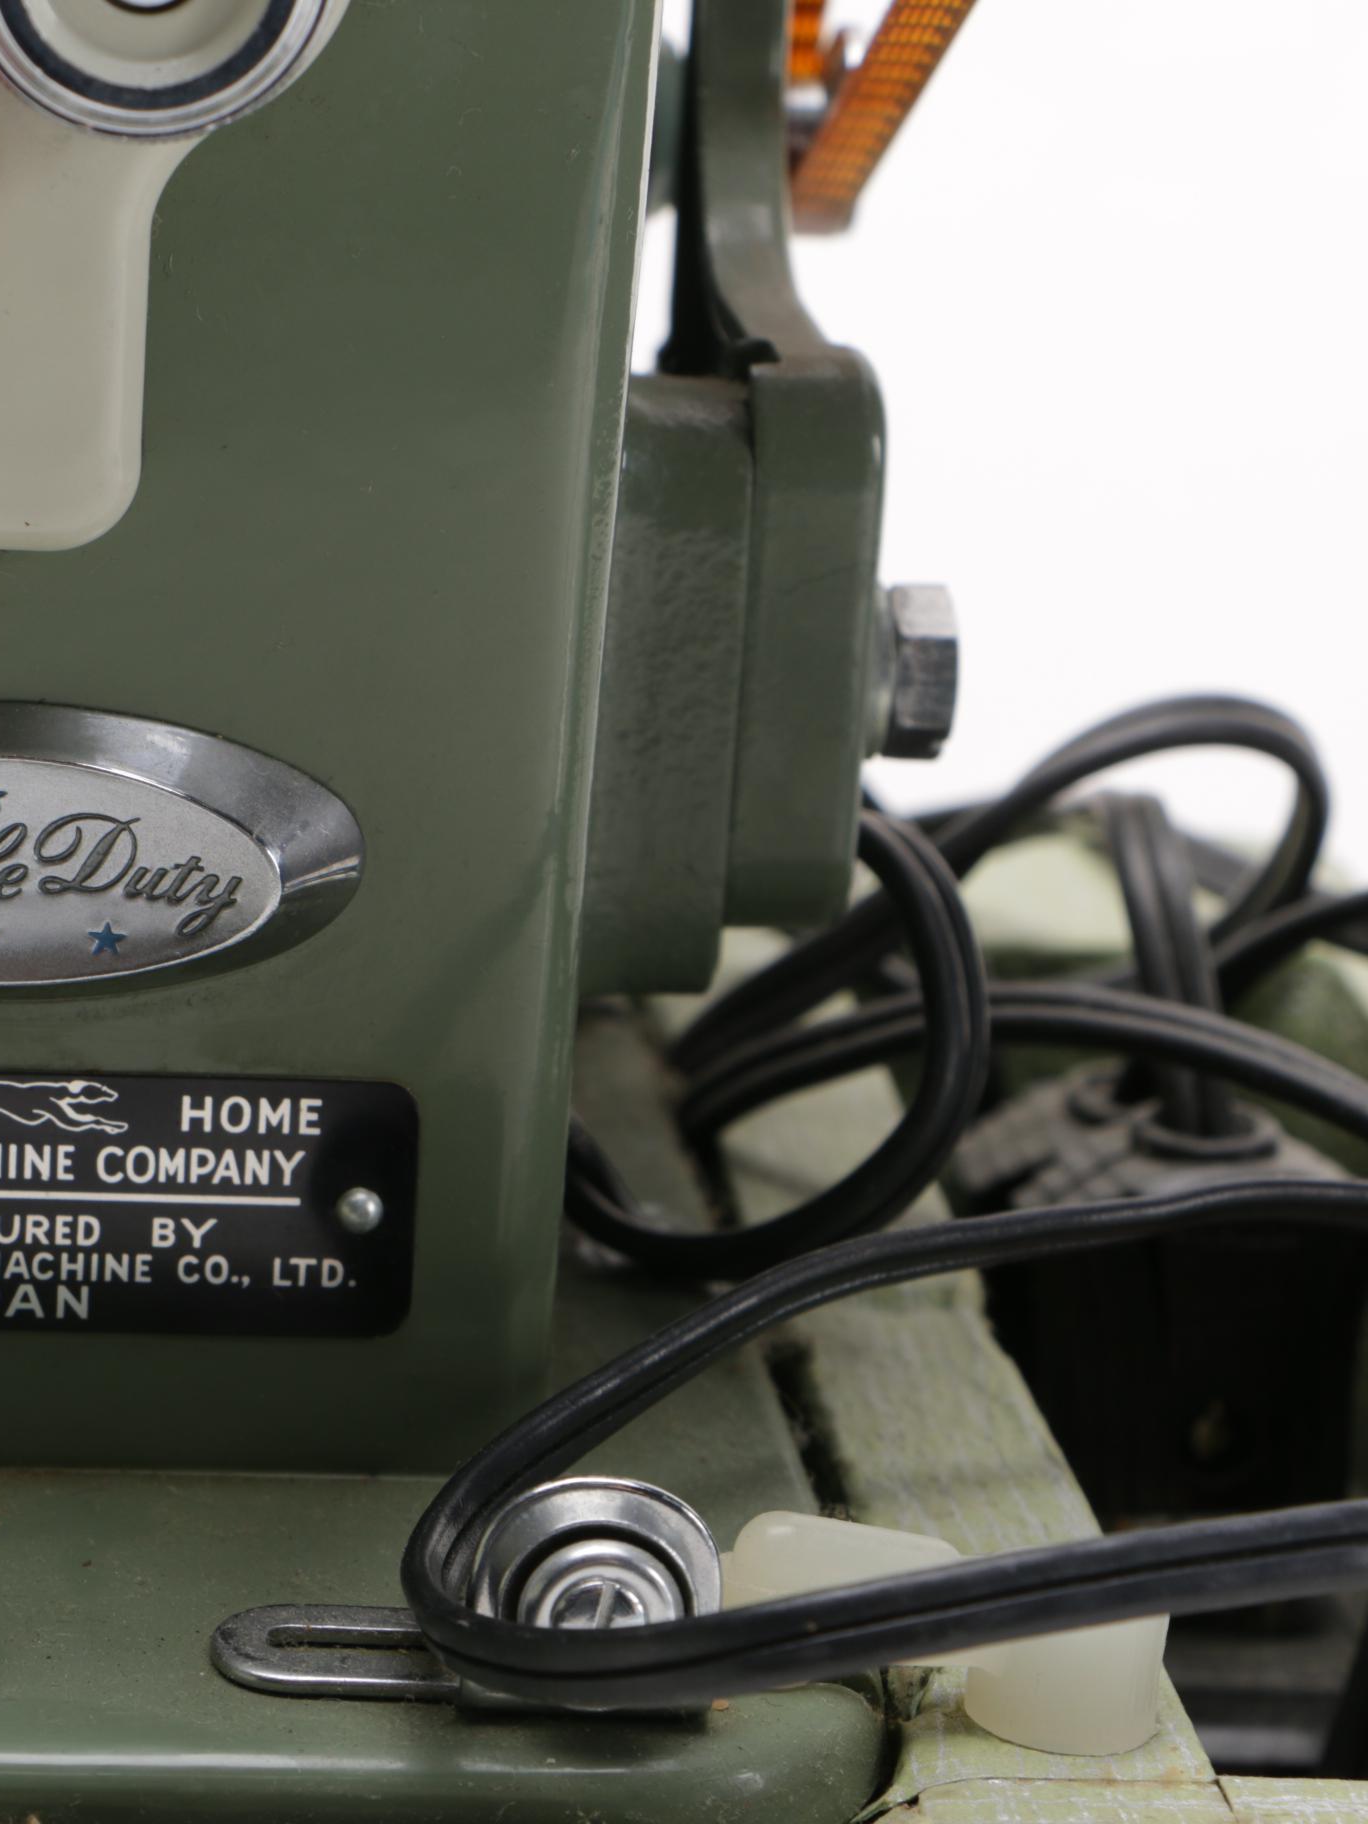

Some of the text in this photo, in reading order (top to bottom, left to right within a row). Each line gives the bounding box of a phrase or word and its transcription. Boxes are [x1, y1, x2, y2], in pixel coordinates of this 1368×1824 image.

[33, 811, 244, 937] Duty
[181, 1095, 323, 1135] HOME
[96, 1145, 306, 1185] COMPANY
[151, 1217, 218, 1248] BY
[177, 1255, 250, 1288] CO.,
[273, 1257, 357, 1288] LTD.
